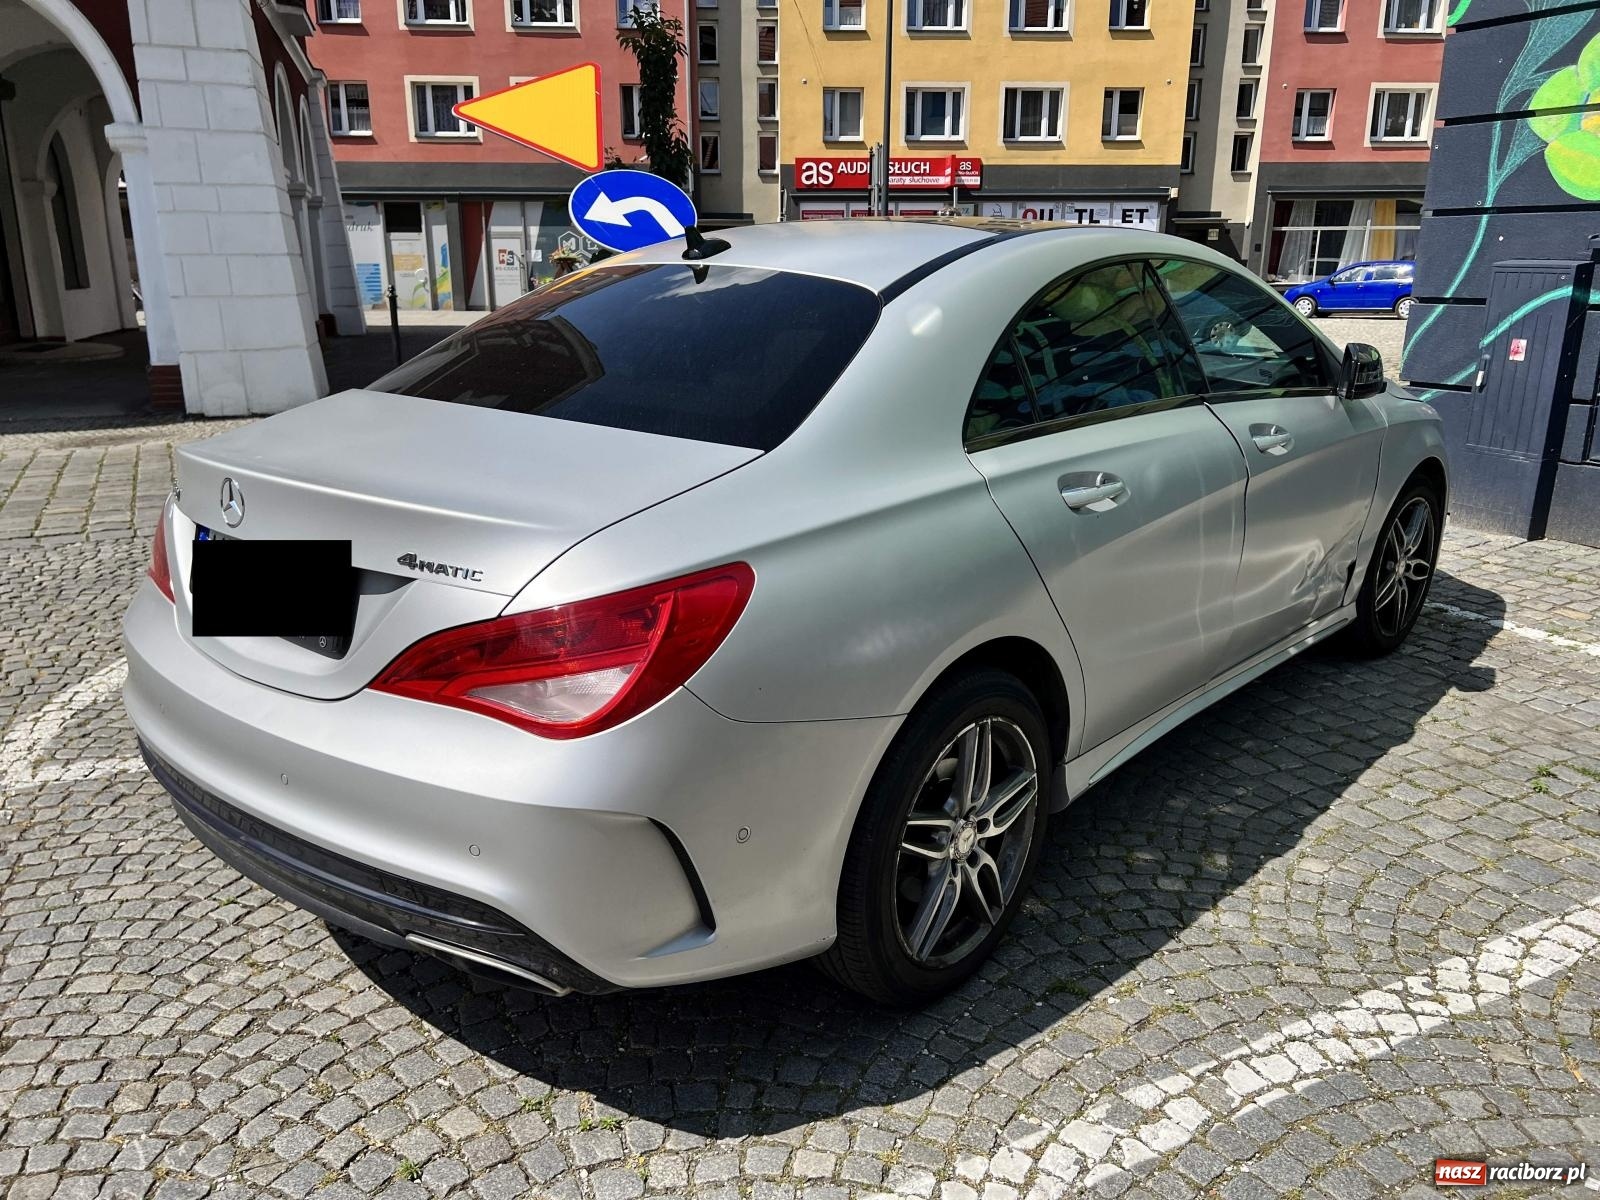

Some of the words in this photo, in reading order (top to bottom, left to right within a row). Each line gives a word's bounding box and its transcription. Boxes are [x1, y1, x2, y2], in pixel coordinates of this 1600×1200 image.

[801, 162, 834, 185] as
[959, 161, 972, 171] as
[397, 551, 484, 582] 4MATIC
